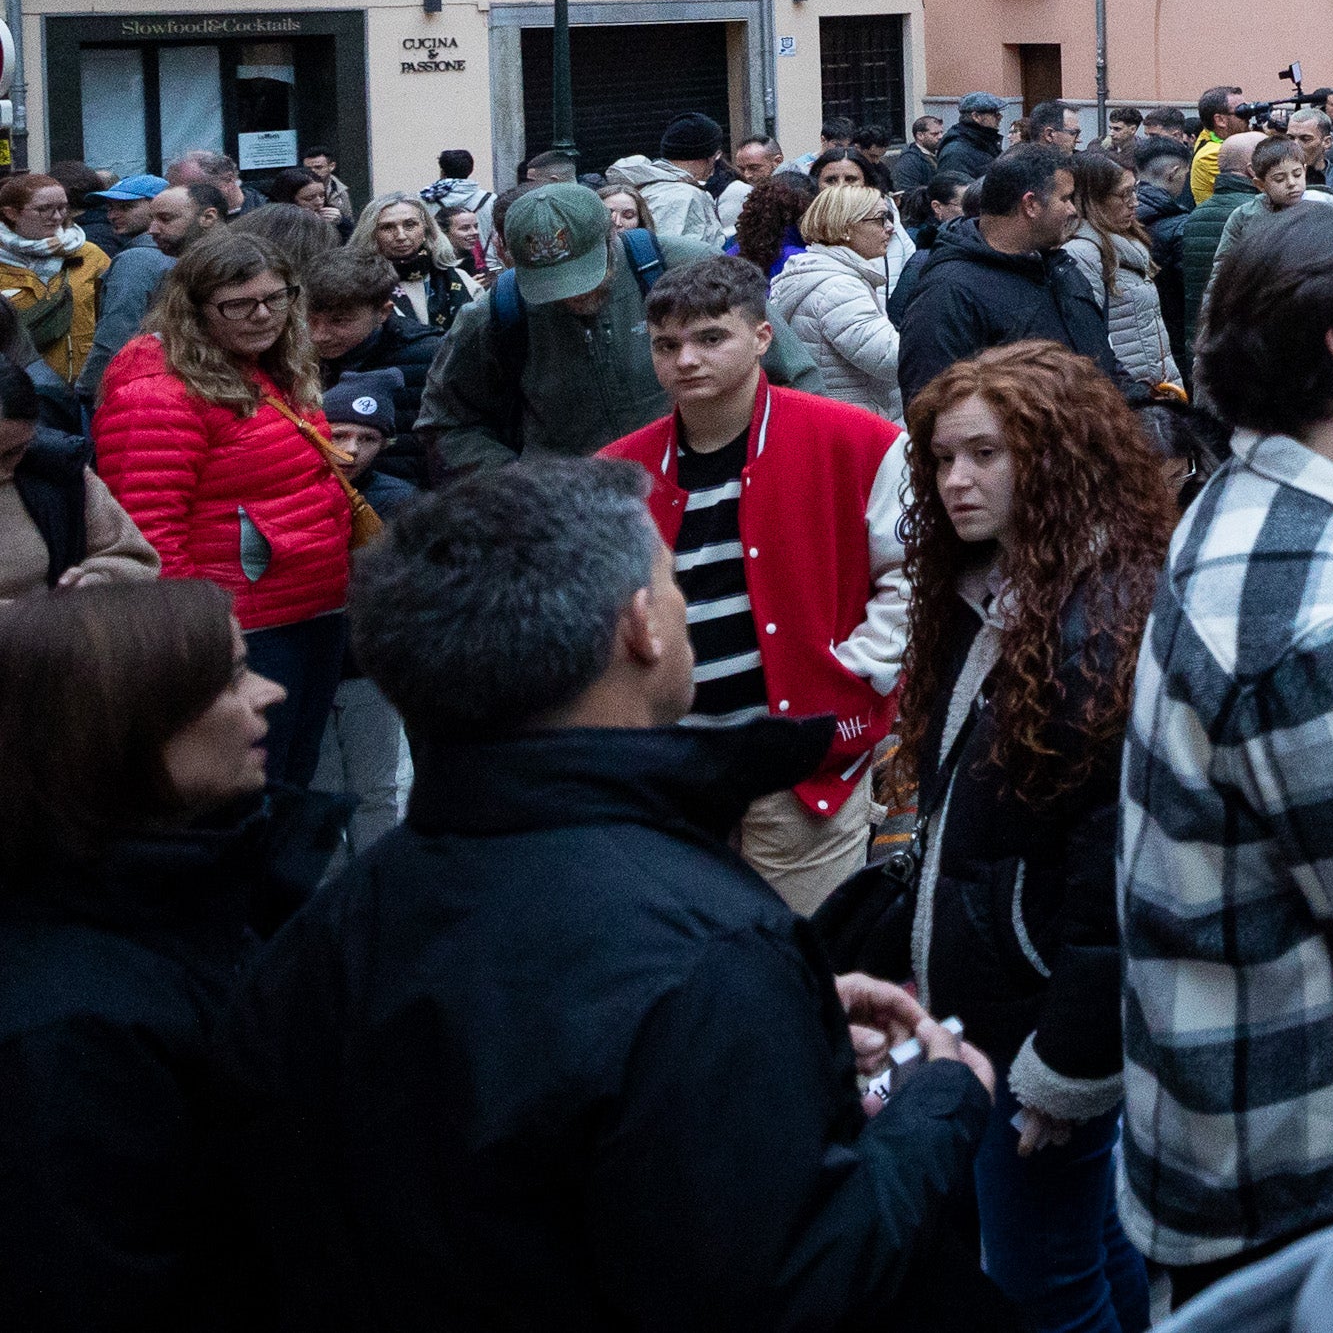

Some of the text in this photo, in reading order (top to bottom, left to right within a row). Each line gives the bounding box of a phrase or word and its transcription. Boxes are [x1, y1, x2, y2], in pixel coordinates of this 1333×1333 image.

[121, 18, 302, 35] Slowfood&Cocktails
[403, 37, 459, 51] CUCINA
[428, 49, 440, 59] &
[400, 60, 467, 74] PASSIONE
